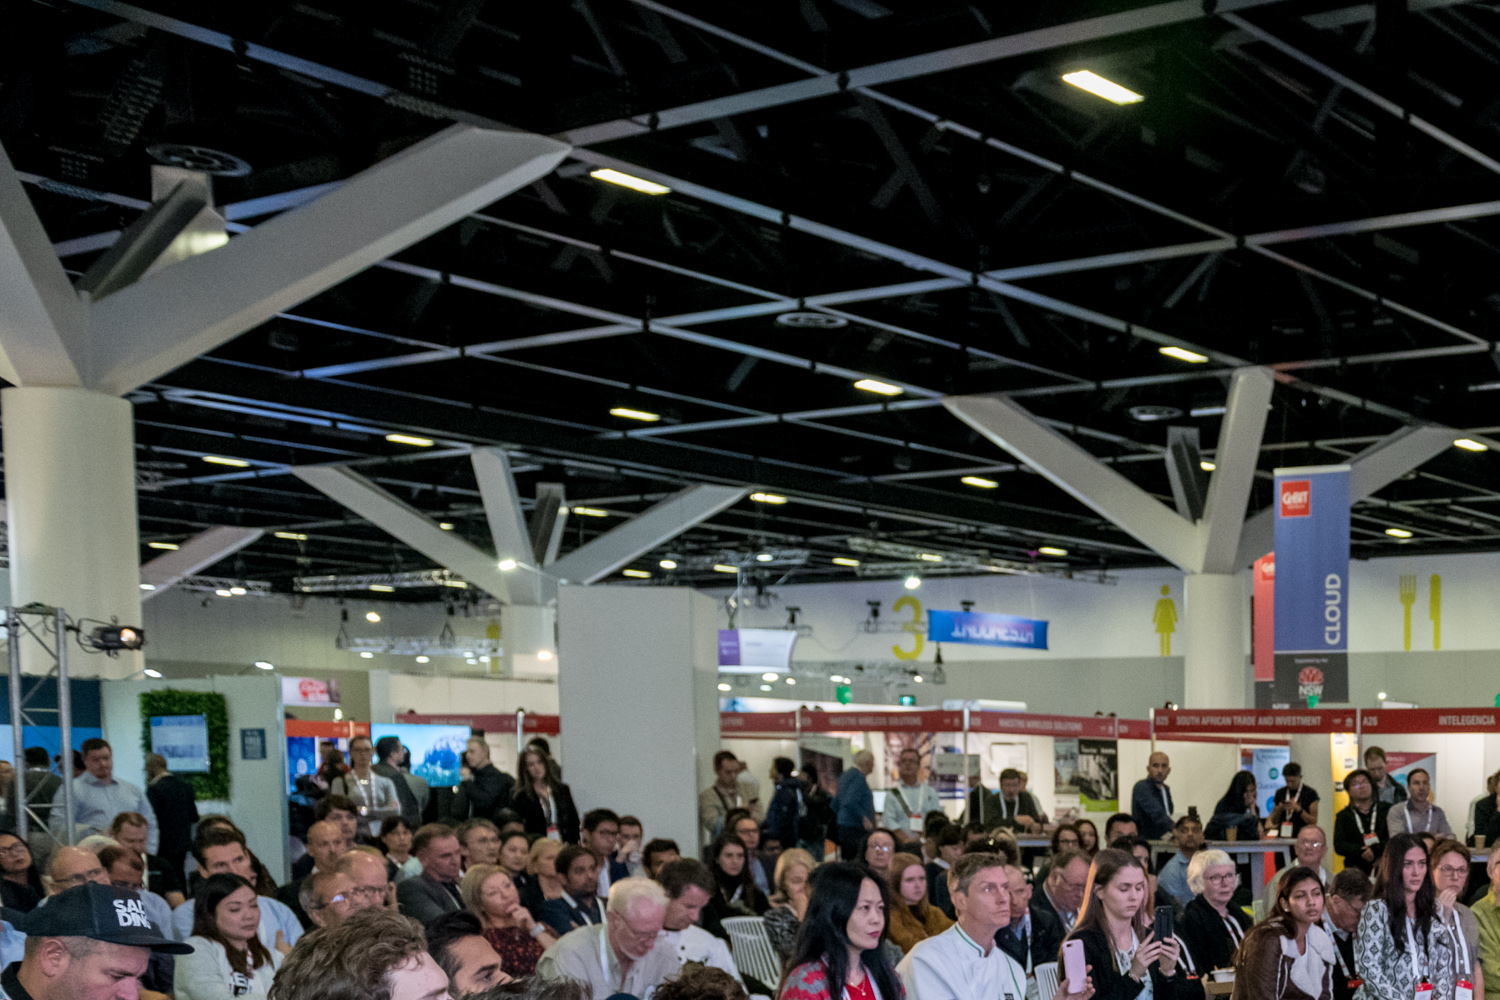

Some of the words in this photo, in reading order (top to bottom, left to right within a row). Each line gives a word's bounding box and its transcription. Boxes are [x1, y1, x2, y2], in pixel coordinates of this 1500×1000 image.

[1325, 573, 1341, 645] CLOUD
[892, 595, 924, 661] 3
[1201, 715, 1232, 726] AFRICAN
[1233, 715, 1256, 726] TRADE
[1258, 715, 1274, 726] AND
[1275, 715, 1322, 726] INVESTMENT
[1438, 715, 1496, 726] INTELEGENCIA
[112, 898, 145, 913] SAL
